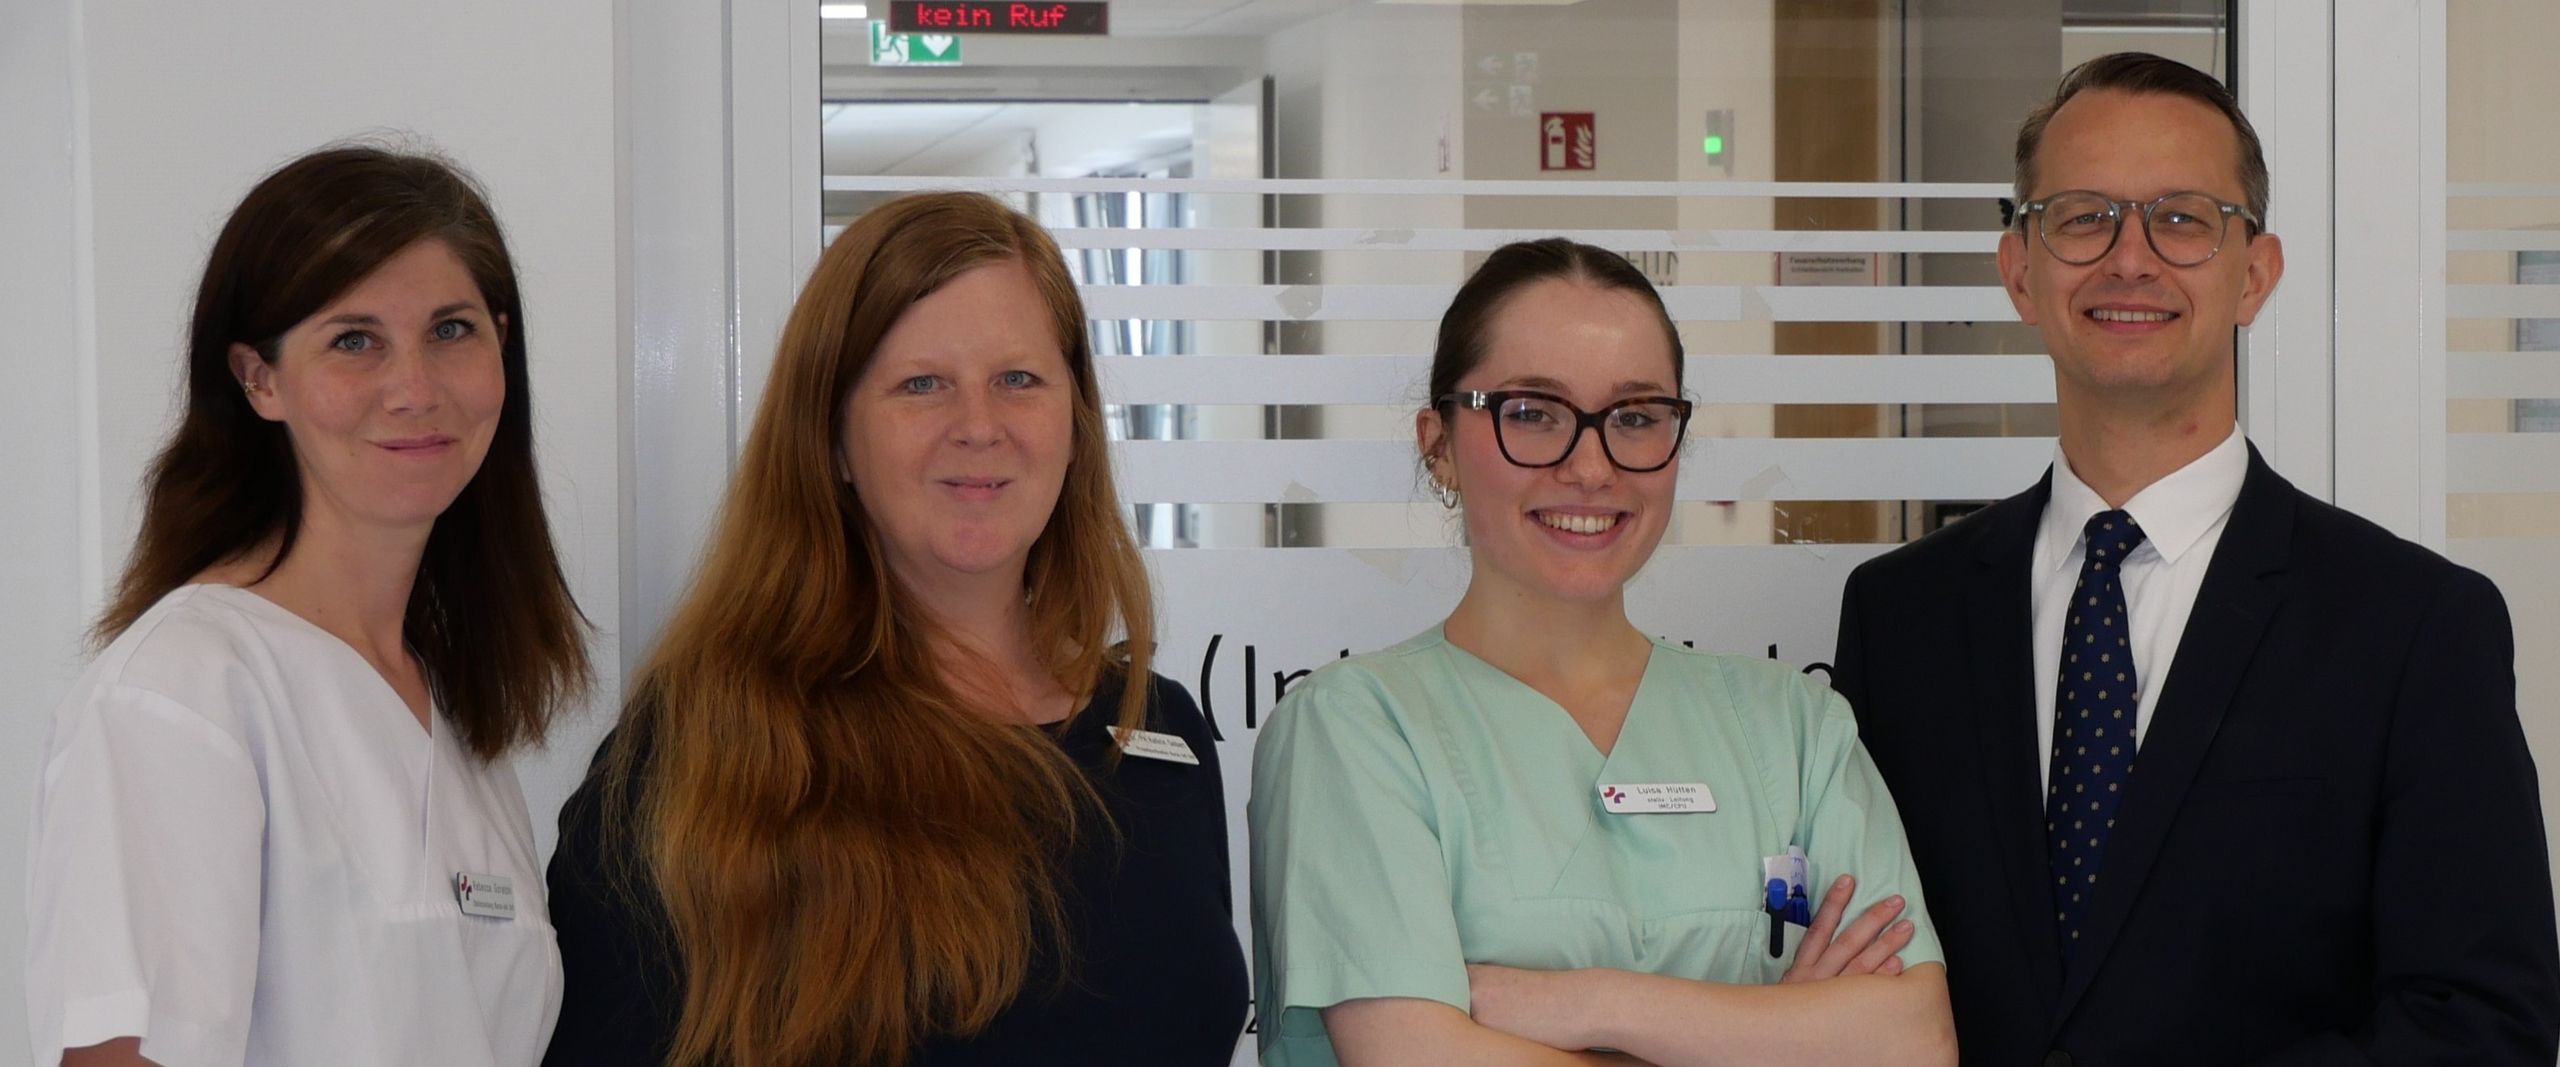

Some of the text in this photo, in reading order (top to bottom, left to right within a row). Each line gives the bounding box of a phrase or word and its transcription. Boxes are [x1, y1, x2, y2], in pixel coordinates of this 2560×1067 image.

[916, 3, 1067, 27] kein Ruf
[1636, 785, 1662, 795] Luisa
